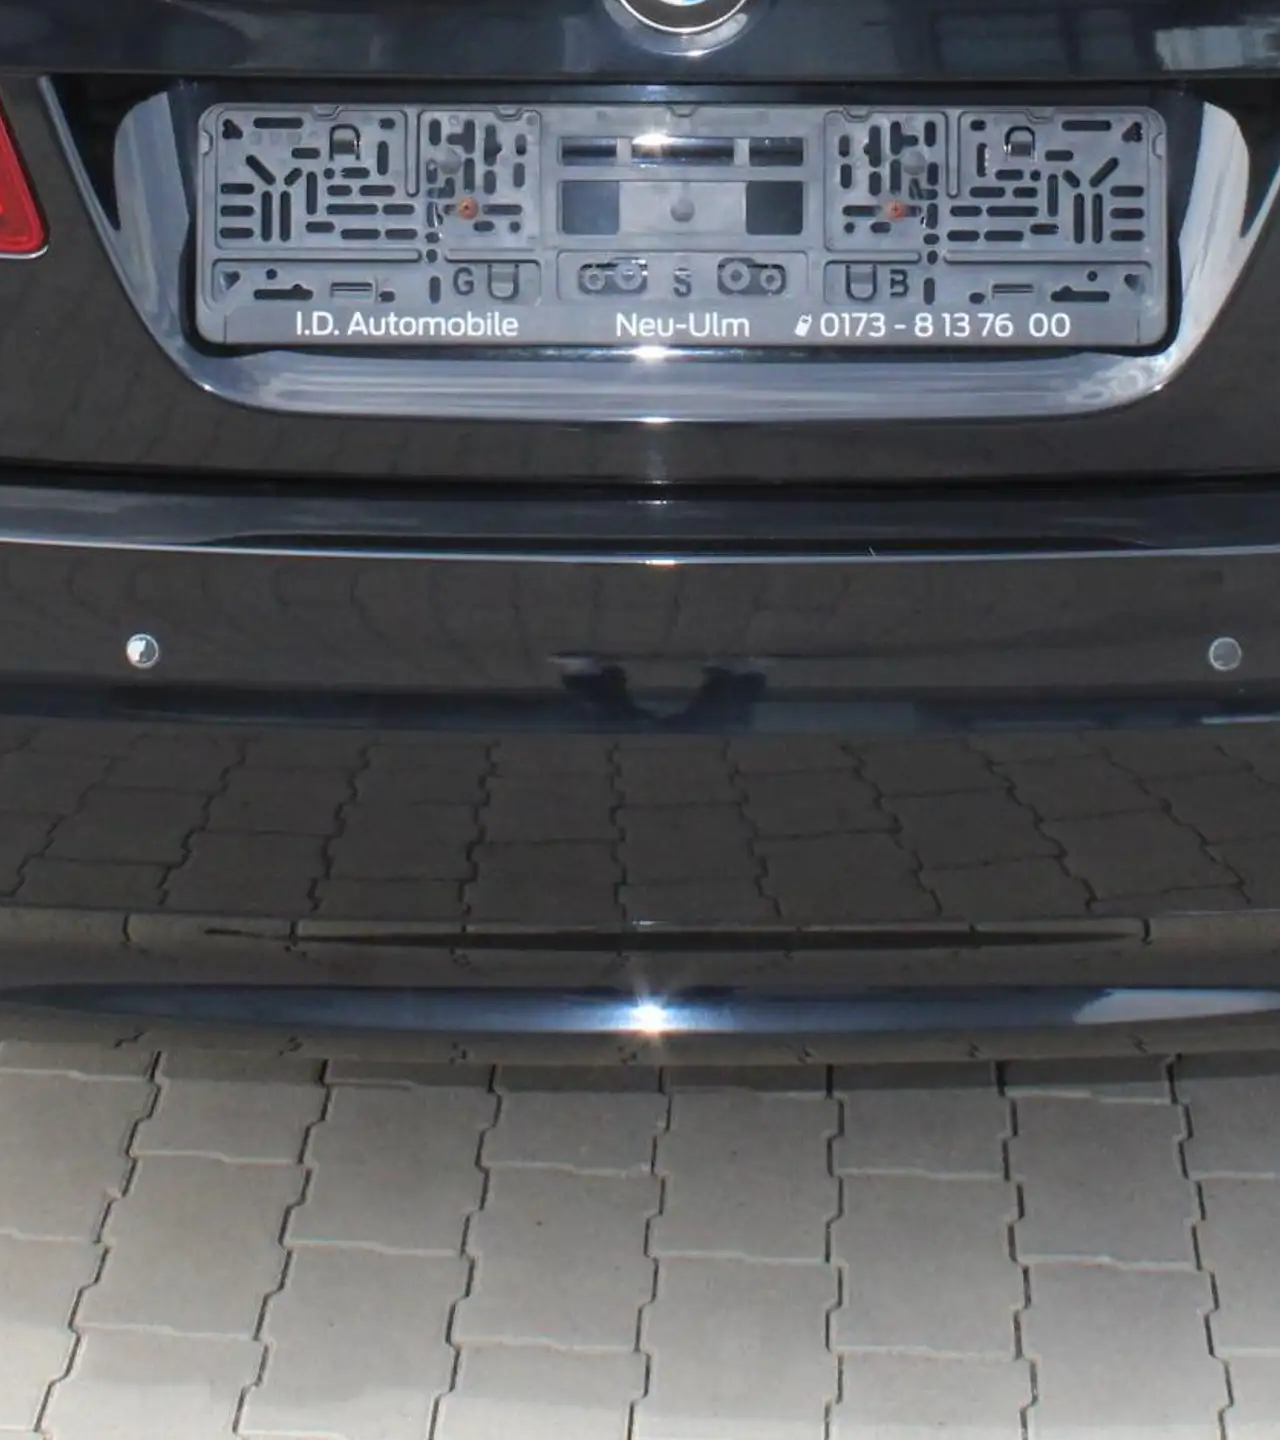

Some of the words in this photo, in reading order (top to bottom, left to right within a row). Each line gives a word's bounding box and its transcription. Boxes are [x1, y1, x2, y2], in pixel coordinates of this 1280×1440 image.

[296, 311, 339, 336] I.D.
[347, 310, 519, 337] Automobile
[616, 312, 750, 337] Neu-Ulm
[820, 312, 886, 337] 0173
[941, 312, 970, 337] 13
[978, 312, 1014, 337] 76
[1028, 312, 1071, 337] 00
